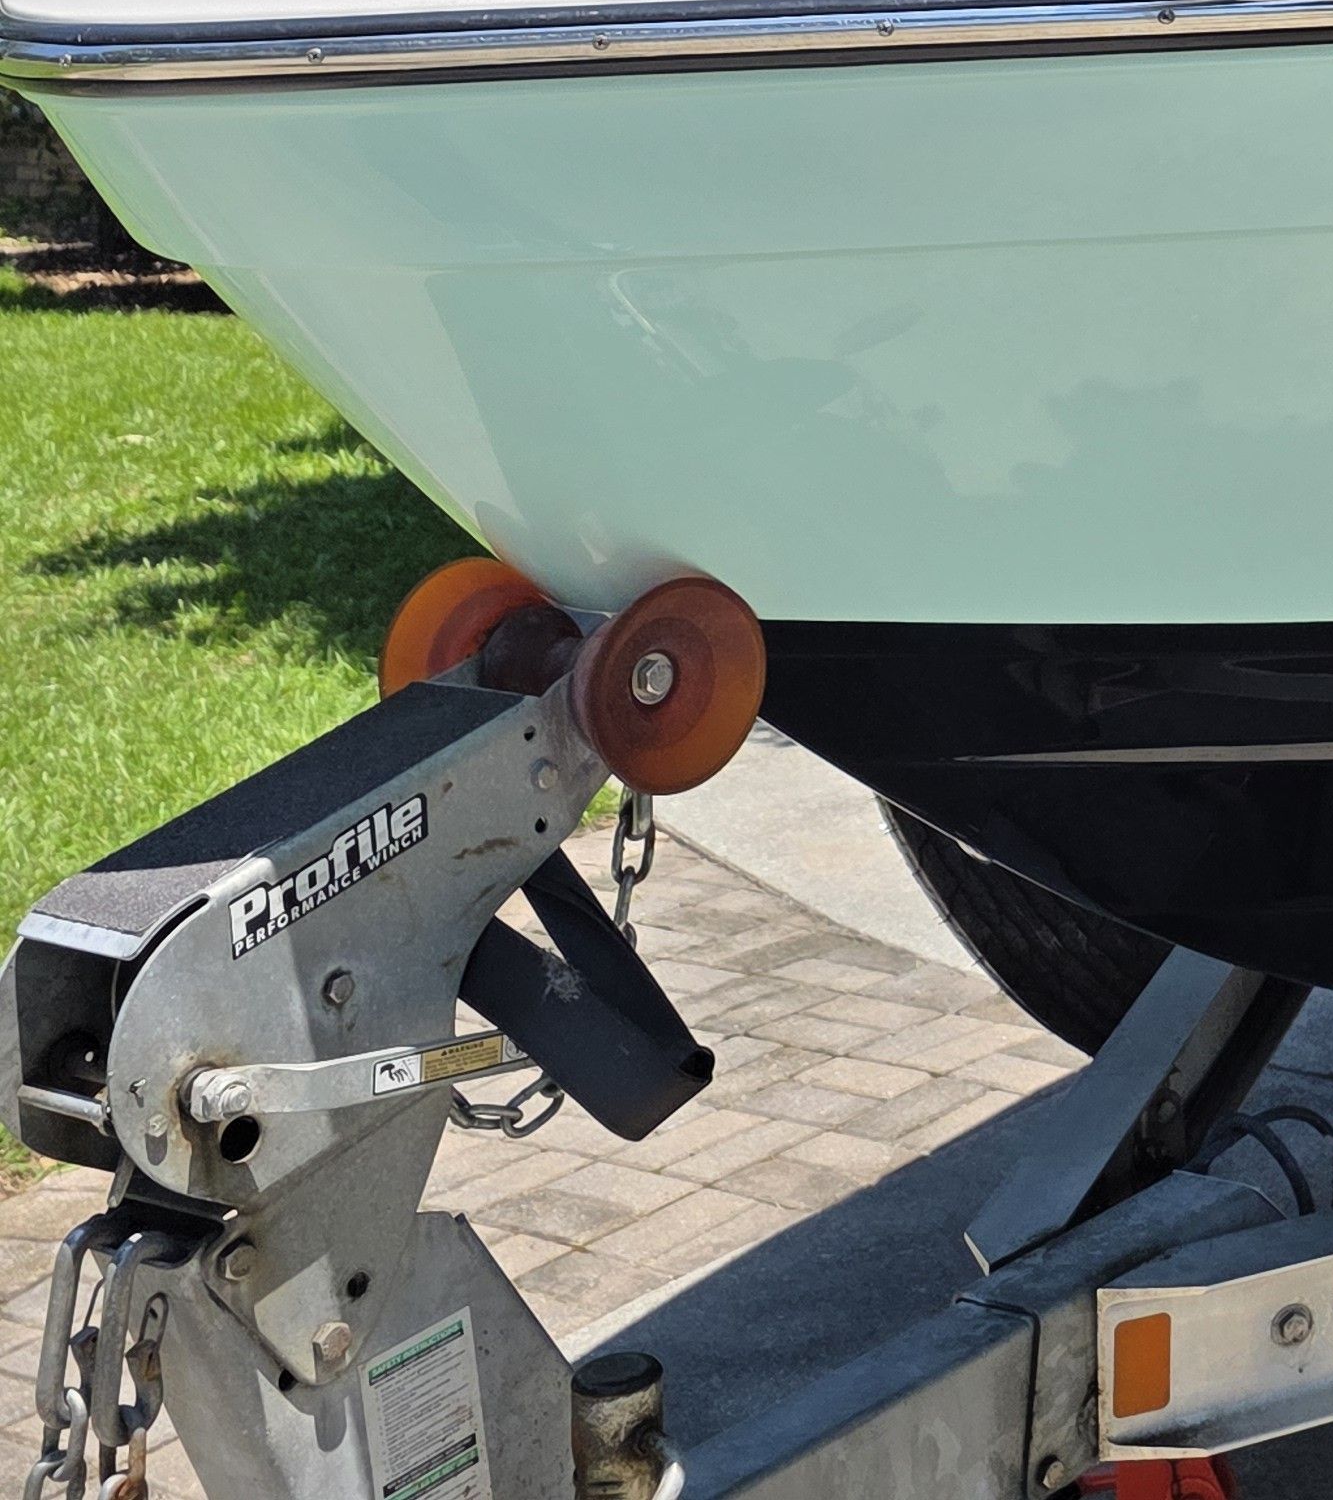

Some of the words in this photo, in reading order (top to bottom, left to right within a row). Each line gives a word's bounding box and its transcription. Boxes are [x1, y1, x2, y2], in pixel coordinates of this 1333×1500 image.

[229, 797, 423, 943] Profile
[234, 866, 361, 956] PERFORMANCE
[366, 826, 422, 870] WINCH
